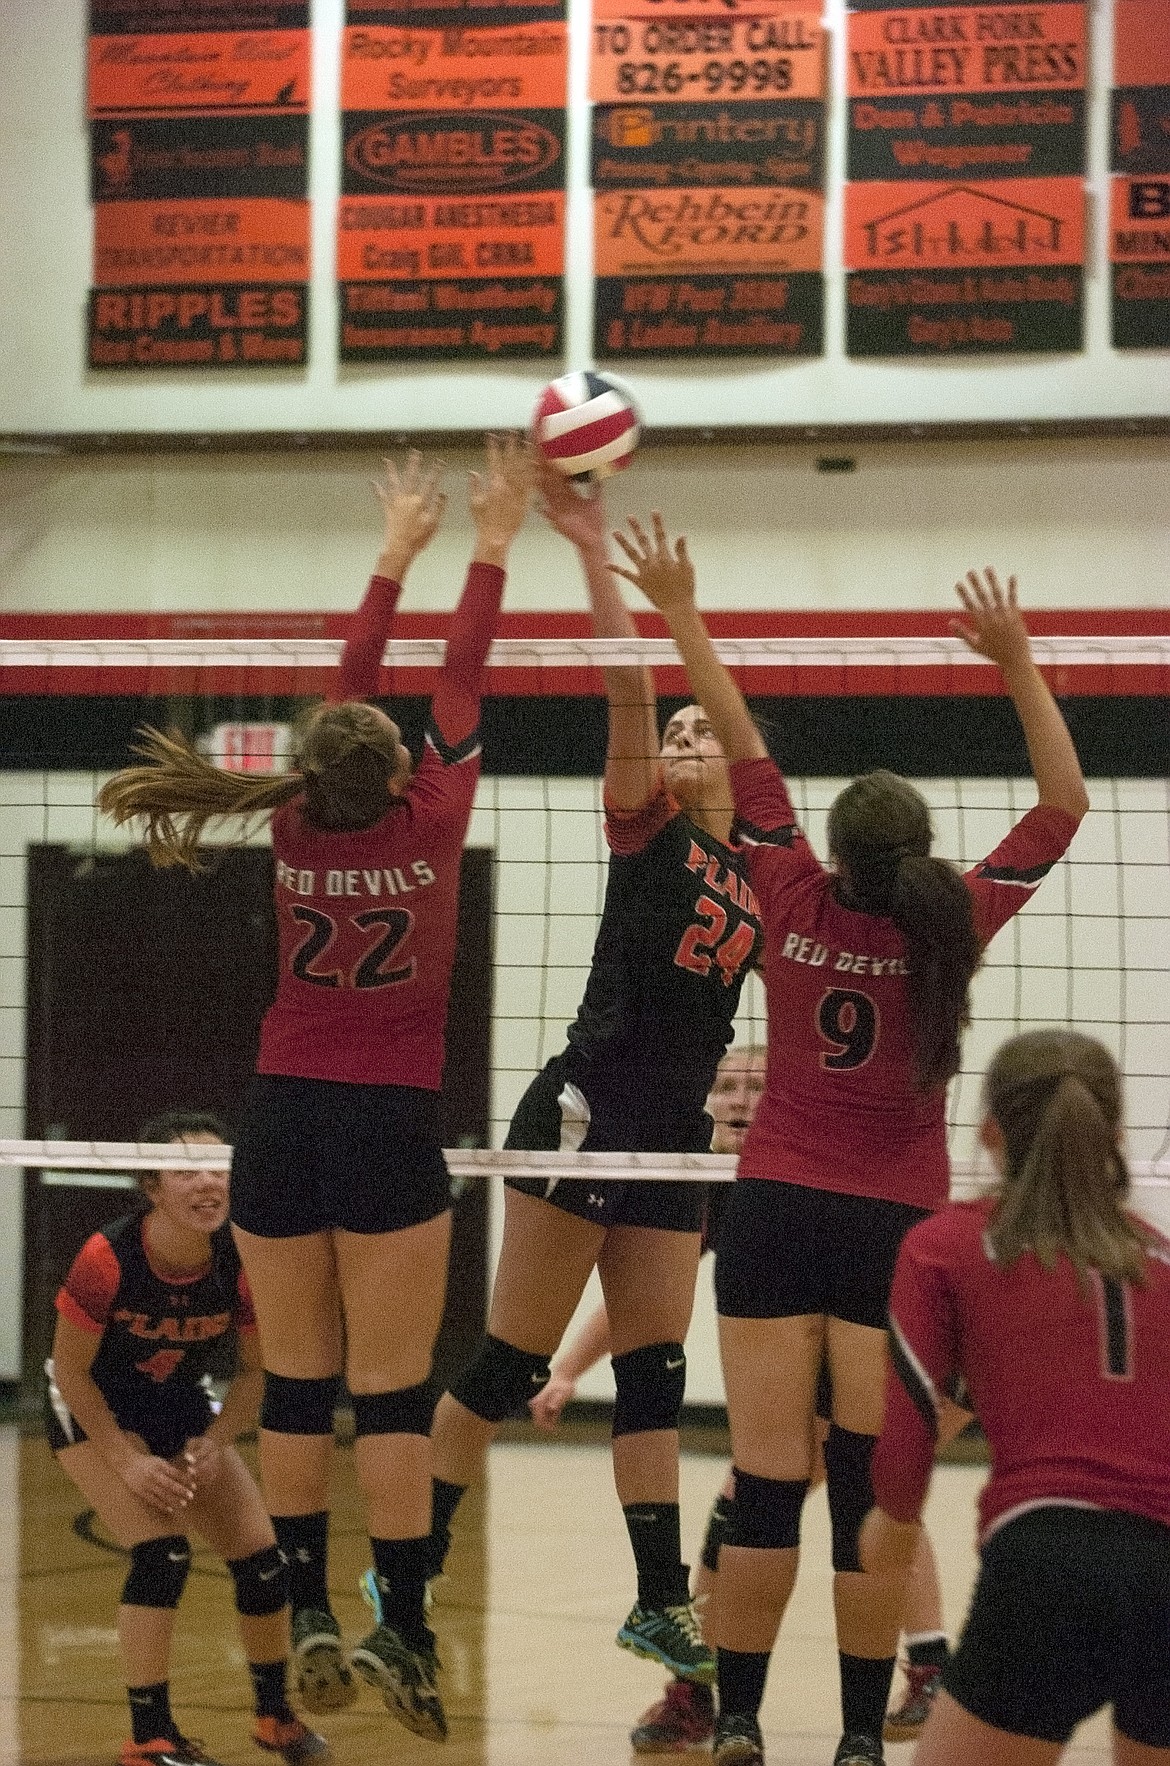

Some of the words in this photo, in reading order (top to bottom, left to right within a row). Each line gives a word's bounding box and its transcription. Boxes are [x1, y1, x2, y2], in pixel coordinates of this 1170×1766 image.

[349, 32, 431, 65] Rocky
[441, 28, 563, 58] Mountain
[595, 25, 629, 54] TO
[644, 22, 734, 54] ORDER
[885, 16, 968, 43] CLARK
[976, 14, 1044, 41] FORK
[617, 59, 793, 94] 826-9998
[853, 48, 969, 88] VALLEY
[983, 44, 1079, 84] PRESS
[389, 73, 521, 104] Surveyors
[363, 130, 541, 164] GAMBLES
[342, 203, 426, 230] COUGAR
[1130, 182, 1170, 218] B
[98, 243, 306, 268] TRANSPORTATION
[1116, 231, 1170, 254] MIN
[97, 292, 301, 330] RIPPLES
[327, 860, 437, 896] DEVILS
[684, 839, 763, 921] PLAIN
[287, 904, 417, 990] 22
[673, 895, 756, 988] 24
[781, 932, 829, 967] RED
[834, 951, 912, 976] DEVIL
[817, 985, 881, 1072] 9
[1087, 1265, 1135, 1382] 1
